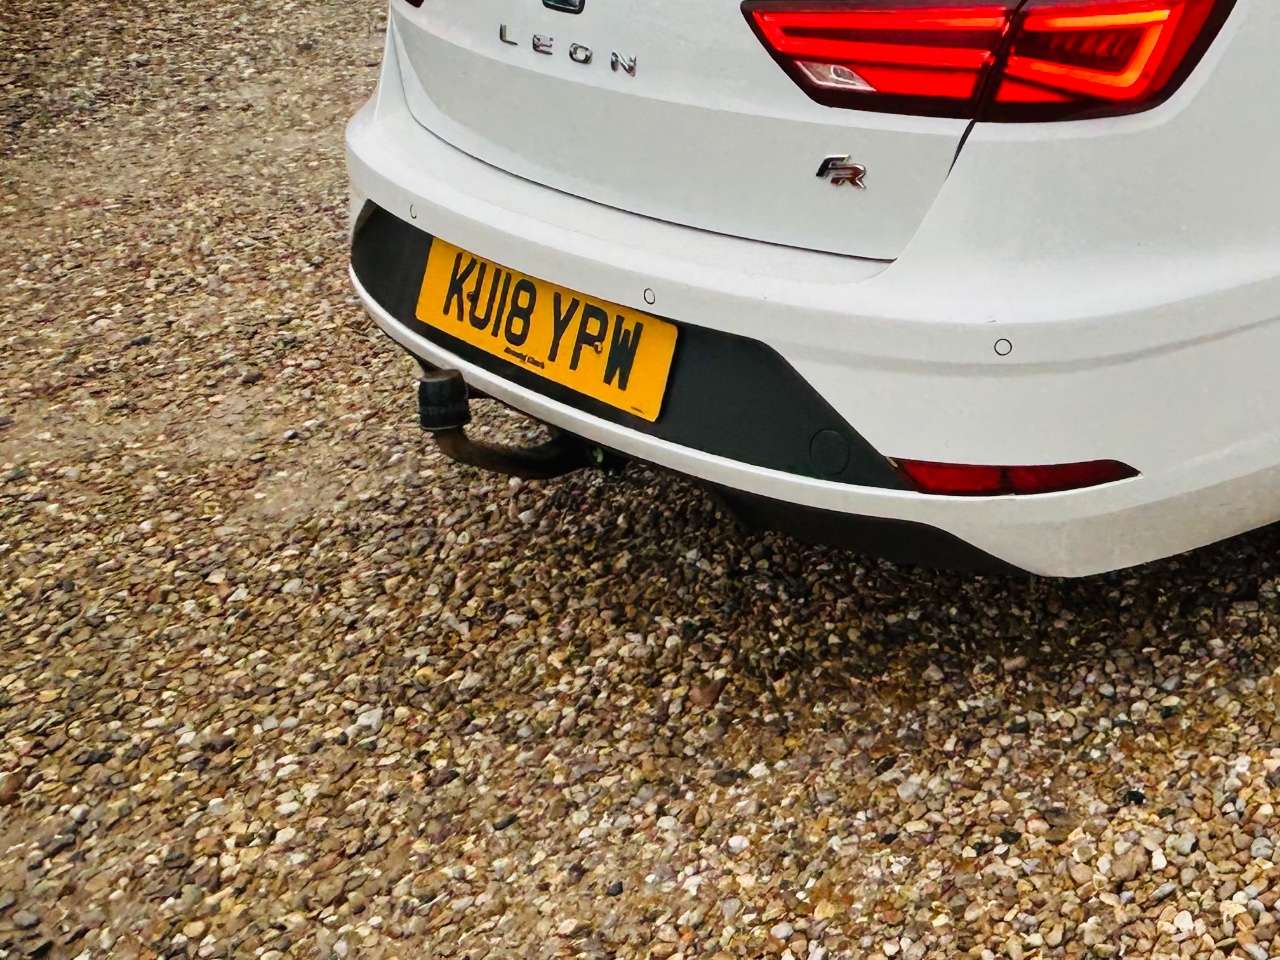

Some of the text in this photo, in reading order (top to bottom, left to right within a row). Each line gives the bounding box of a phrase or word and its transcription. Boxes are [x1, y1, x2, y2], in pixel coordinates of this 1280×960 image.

[500, 23, 637, 77] LEON
[816, 153, 868, 190] FR
[443, 251, 643, 391] KU18 YPW
